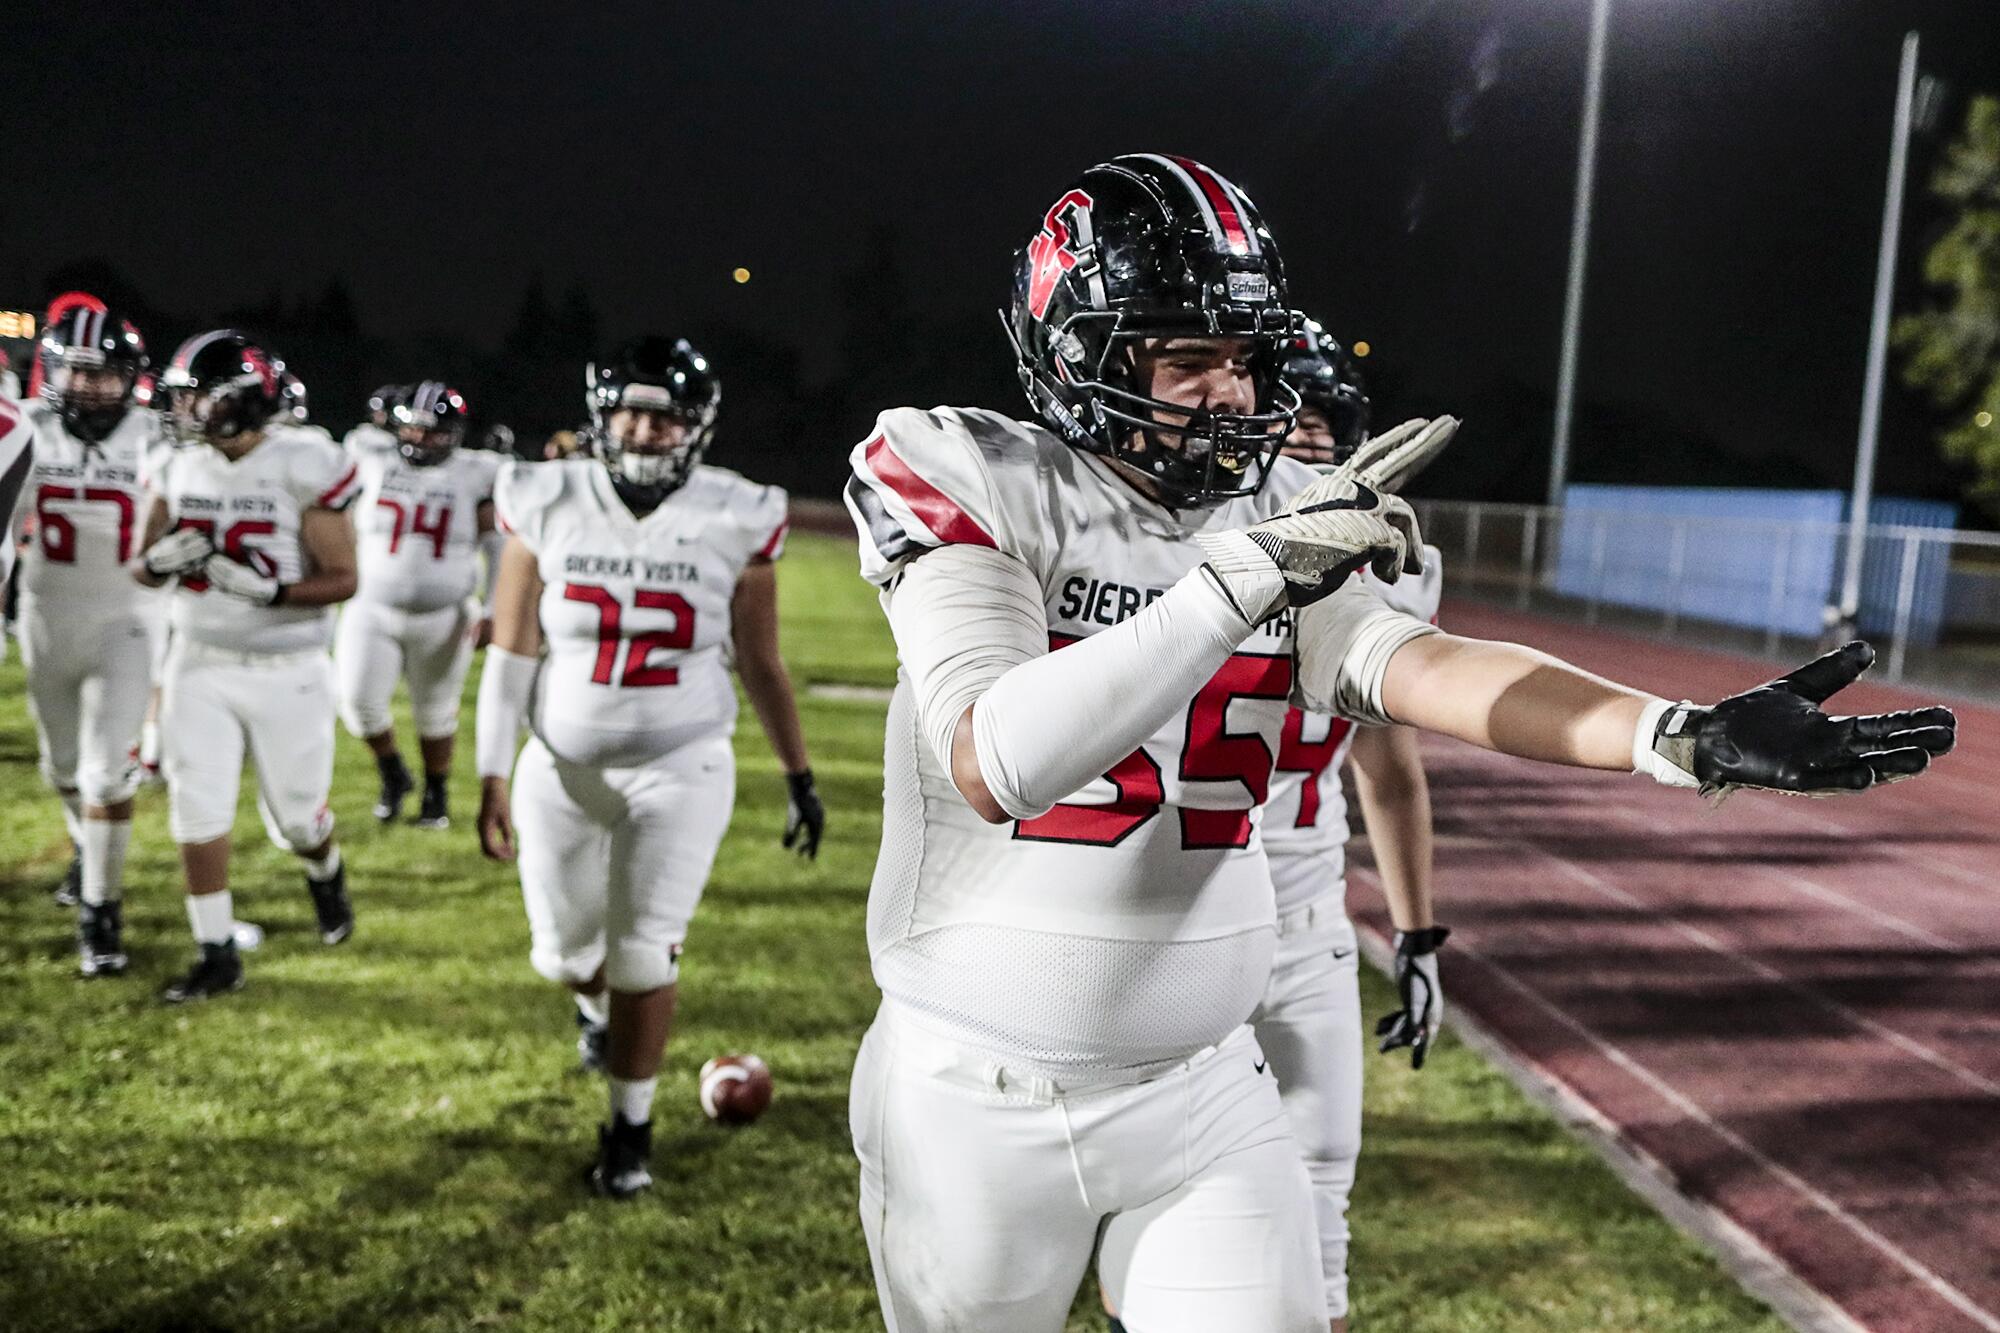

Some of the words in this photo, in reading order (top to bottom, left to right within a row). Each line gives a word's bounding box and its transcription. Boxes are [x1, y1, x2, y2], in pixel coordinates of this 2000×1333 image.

[37, 484, 134, 565] 67
[377, 498, 451, 558] 74
[564, 582, 696, 687] 72
